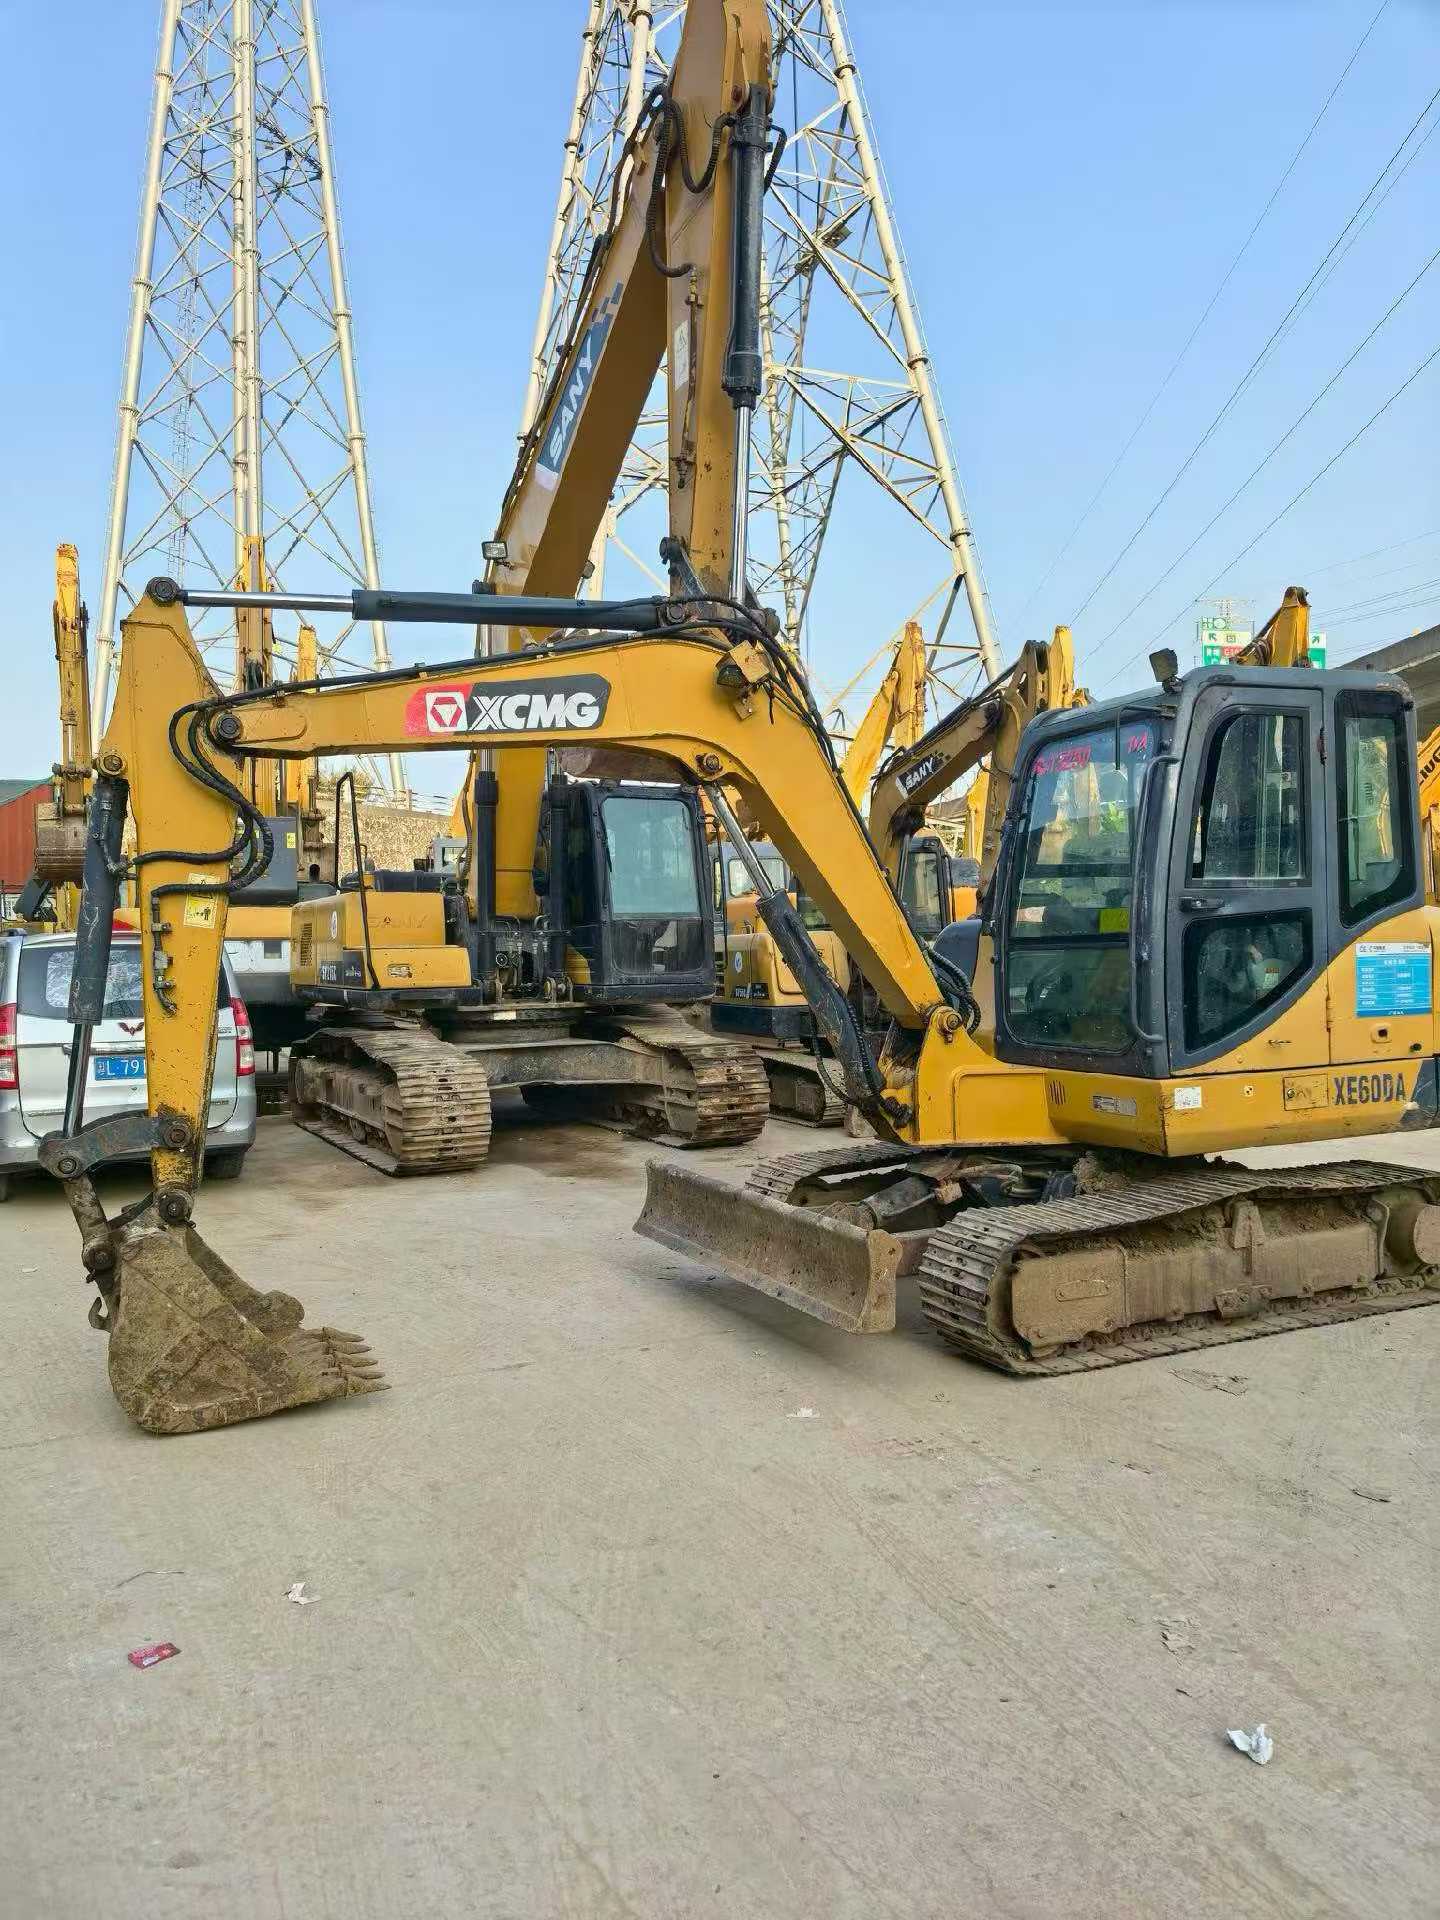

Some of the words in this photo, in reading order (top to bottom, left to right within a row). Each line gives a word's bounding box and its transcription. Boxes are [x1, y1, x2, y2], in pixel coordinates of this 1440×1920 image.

[550, 333, 592, 467] SANY
[469, 691, 600, 731] XCMG
[905, 757, 934, 790] SANY
[1333, 1072, 1406, 1106] XE60DA
